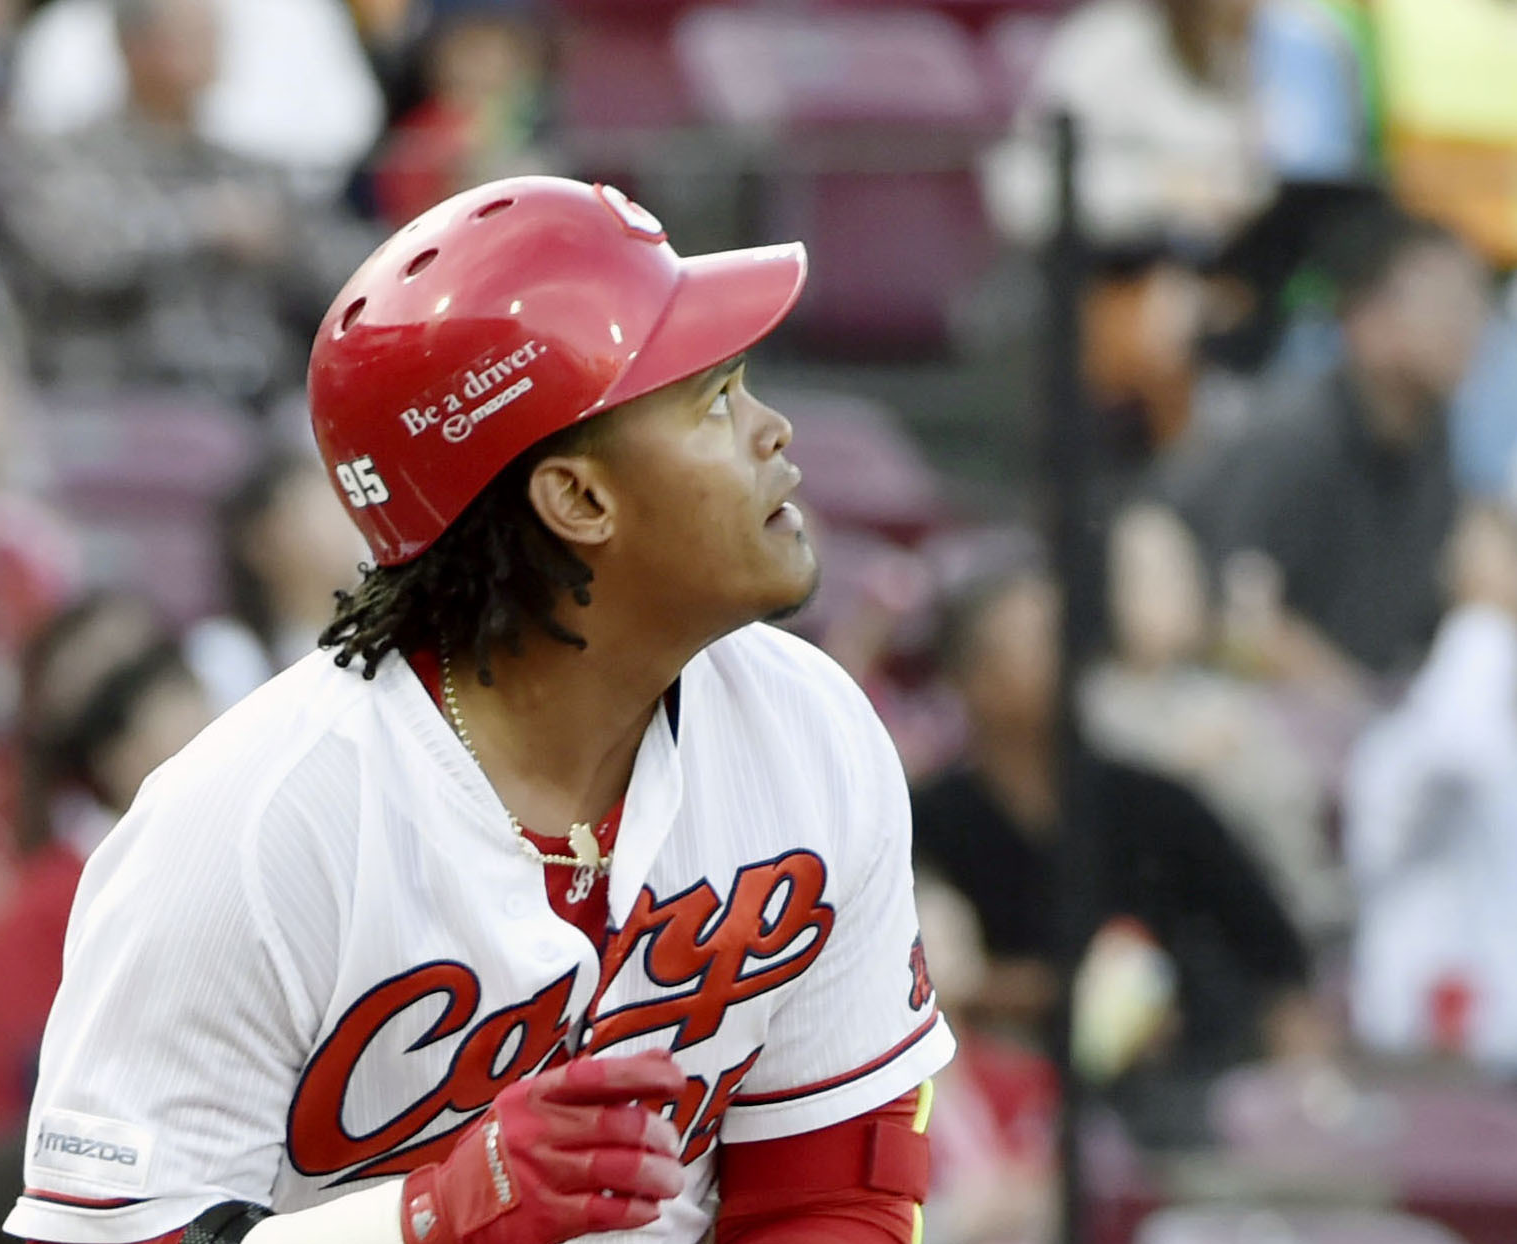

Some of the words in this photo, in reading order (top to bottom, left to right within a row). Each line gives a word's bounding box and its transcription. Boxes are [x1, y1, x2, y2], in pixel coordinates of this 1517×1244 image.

[399, 406, 442, 438] Be
[442, 392, 464, 413] a
[463, 339, 548, 399] driver.
[335, 455, 391, 508] 95
[286, 847, 835, 1190] Carp
[45, 1131, 139, 1167] mazda
